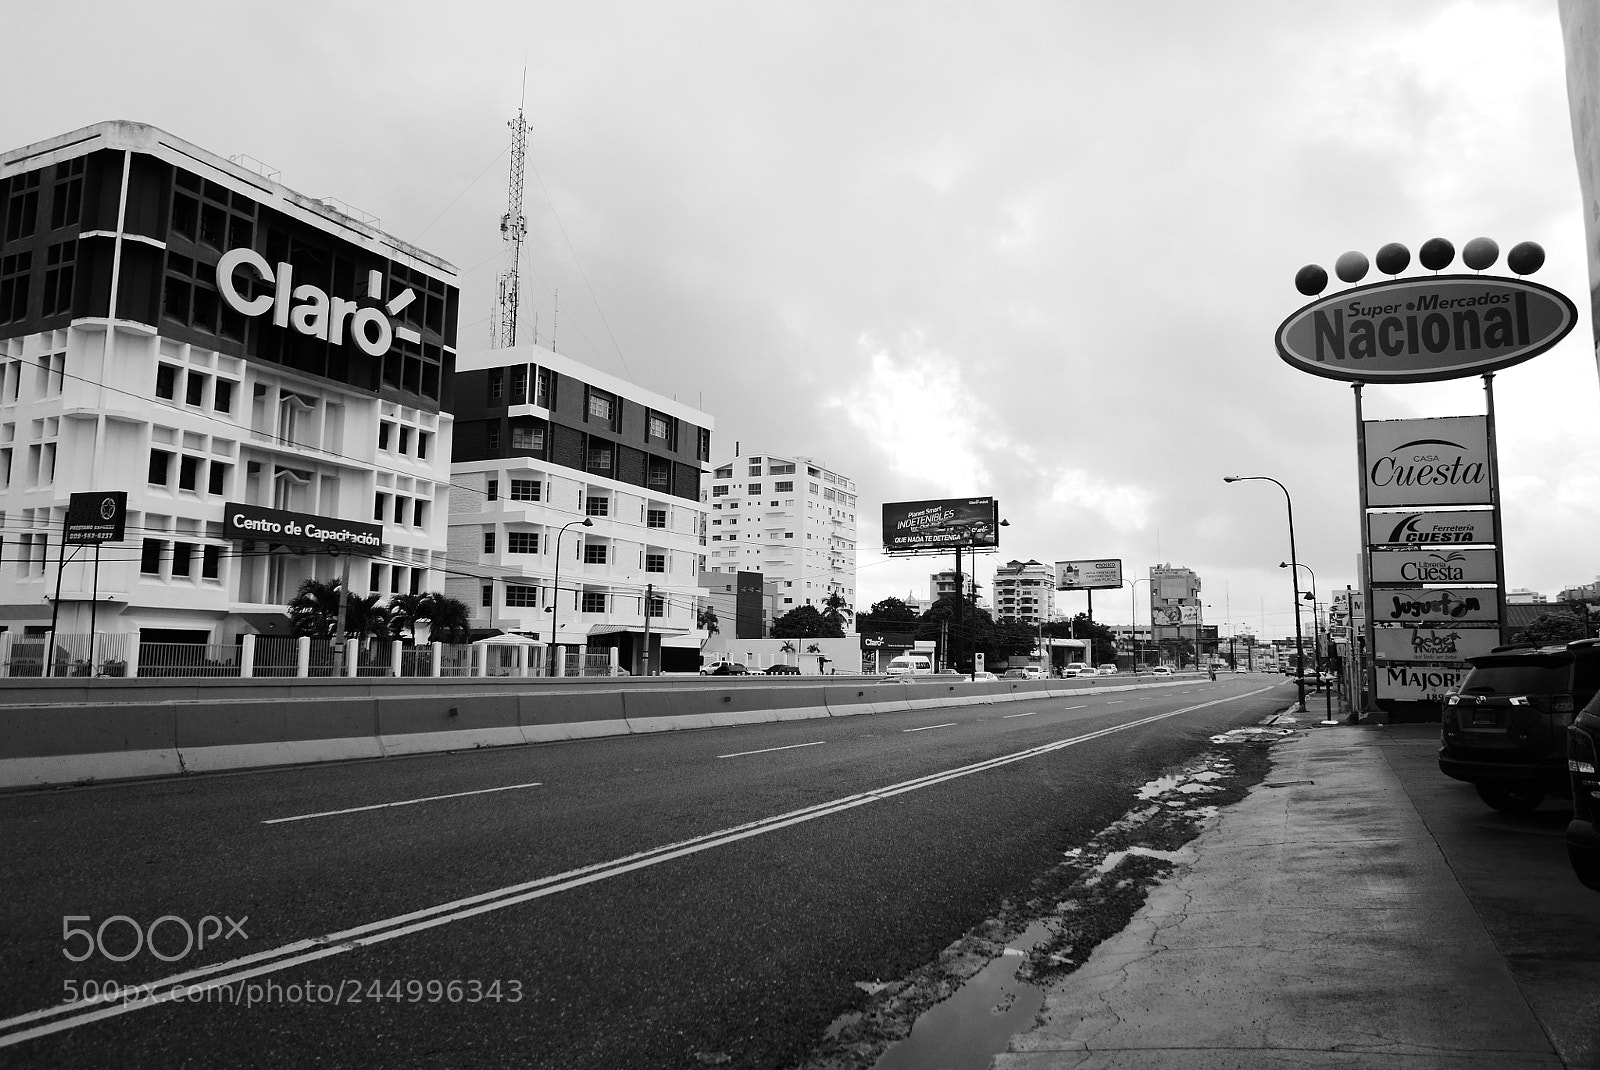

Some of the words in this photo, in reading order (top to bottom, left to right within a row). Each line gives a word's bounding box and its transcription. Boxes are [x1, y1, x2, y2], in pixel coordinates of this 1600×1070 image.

[216, 247, 393, 357] Claro
[1347, 301, 1402, 318] Super
[1416, 292, 1511, 312] Mercados
[1313, 291, 1531, 362] Nacional
[1413, 455, 1440, 463] CASA
[1371, 456, 1486, 487] Cuesta
[897, 509, 954, 529] INDETENIBLES
[907, 509, 926, 519] Planes
[925, 506, 942, 515] Smart
[233, 513, 283, 534] Centro
[284, 520, 301, 536] de
[304, 523, 381, 547] Capacitación
[894, 536, 907, 544] QUE
[907, 535, 924, 543] NADA
[932, 534, 961, 542] DETENGA
[1405, 532, 1473, 542] CUESTA
[1400, 562, 1464, 580] Cuesta
[864, 637, 884, 646] Claro
